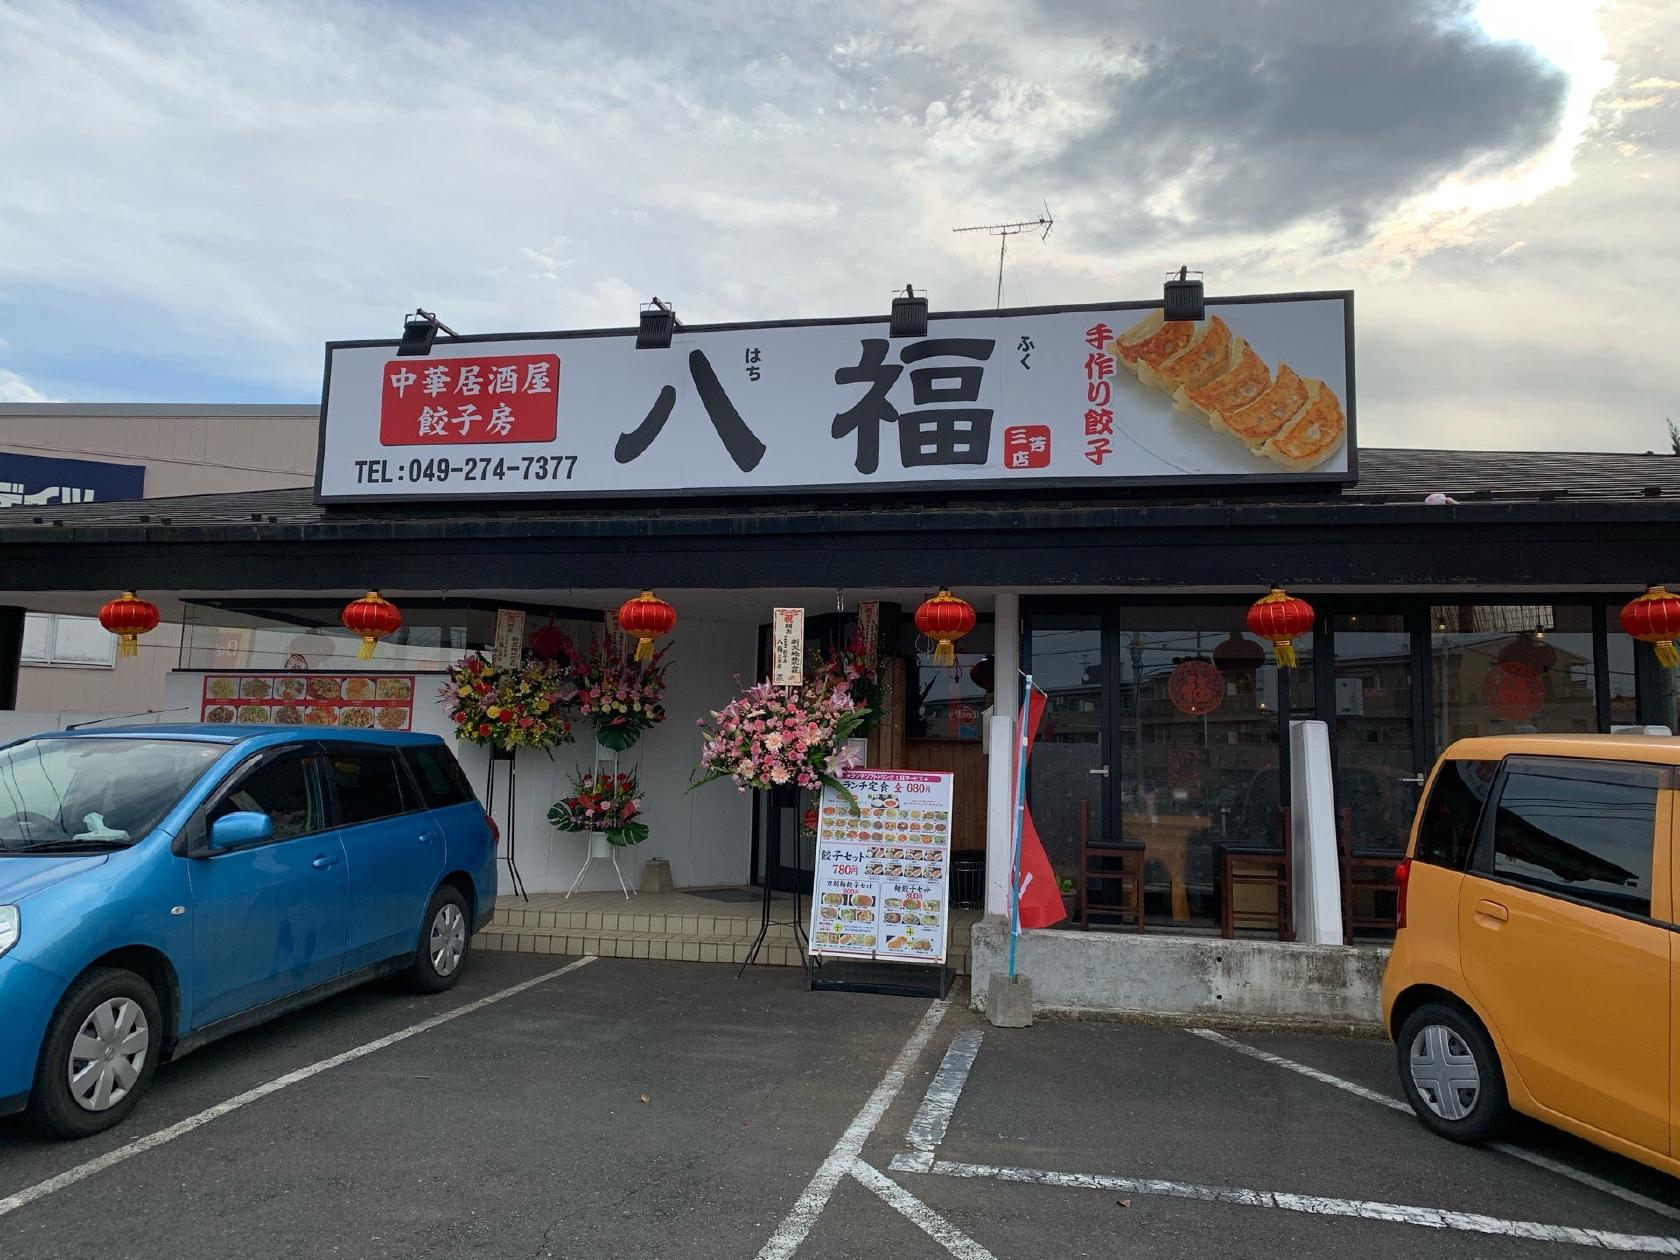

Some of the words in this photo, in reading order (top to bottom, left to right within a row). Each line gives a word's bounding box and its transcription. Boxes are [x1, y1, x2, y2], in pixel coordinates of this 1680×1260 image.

[745, 347, 761, 382] はち
[1017, 335, 1035, 371] ふく
[390, 361, 553, 399] 中華居酒屋
[1084, 323, 1115, 466] 手作り餃子
[417, 402, 516, 437] 餃子房
[821, 849, 866, 862] 餃子セット
